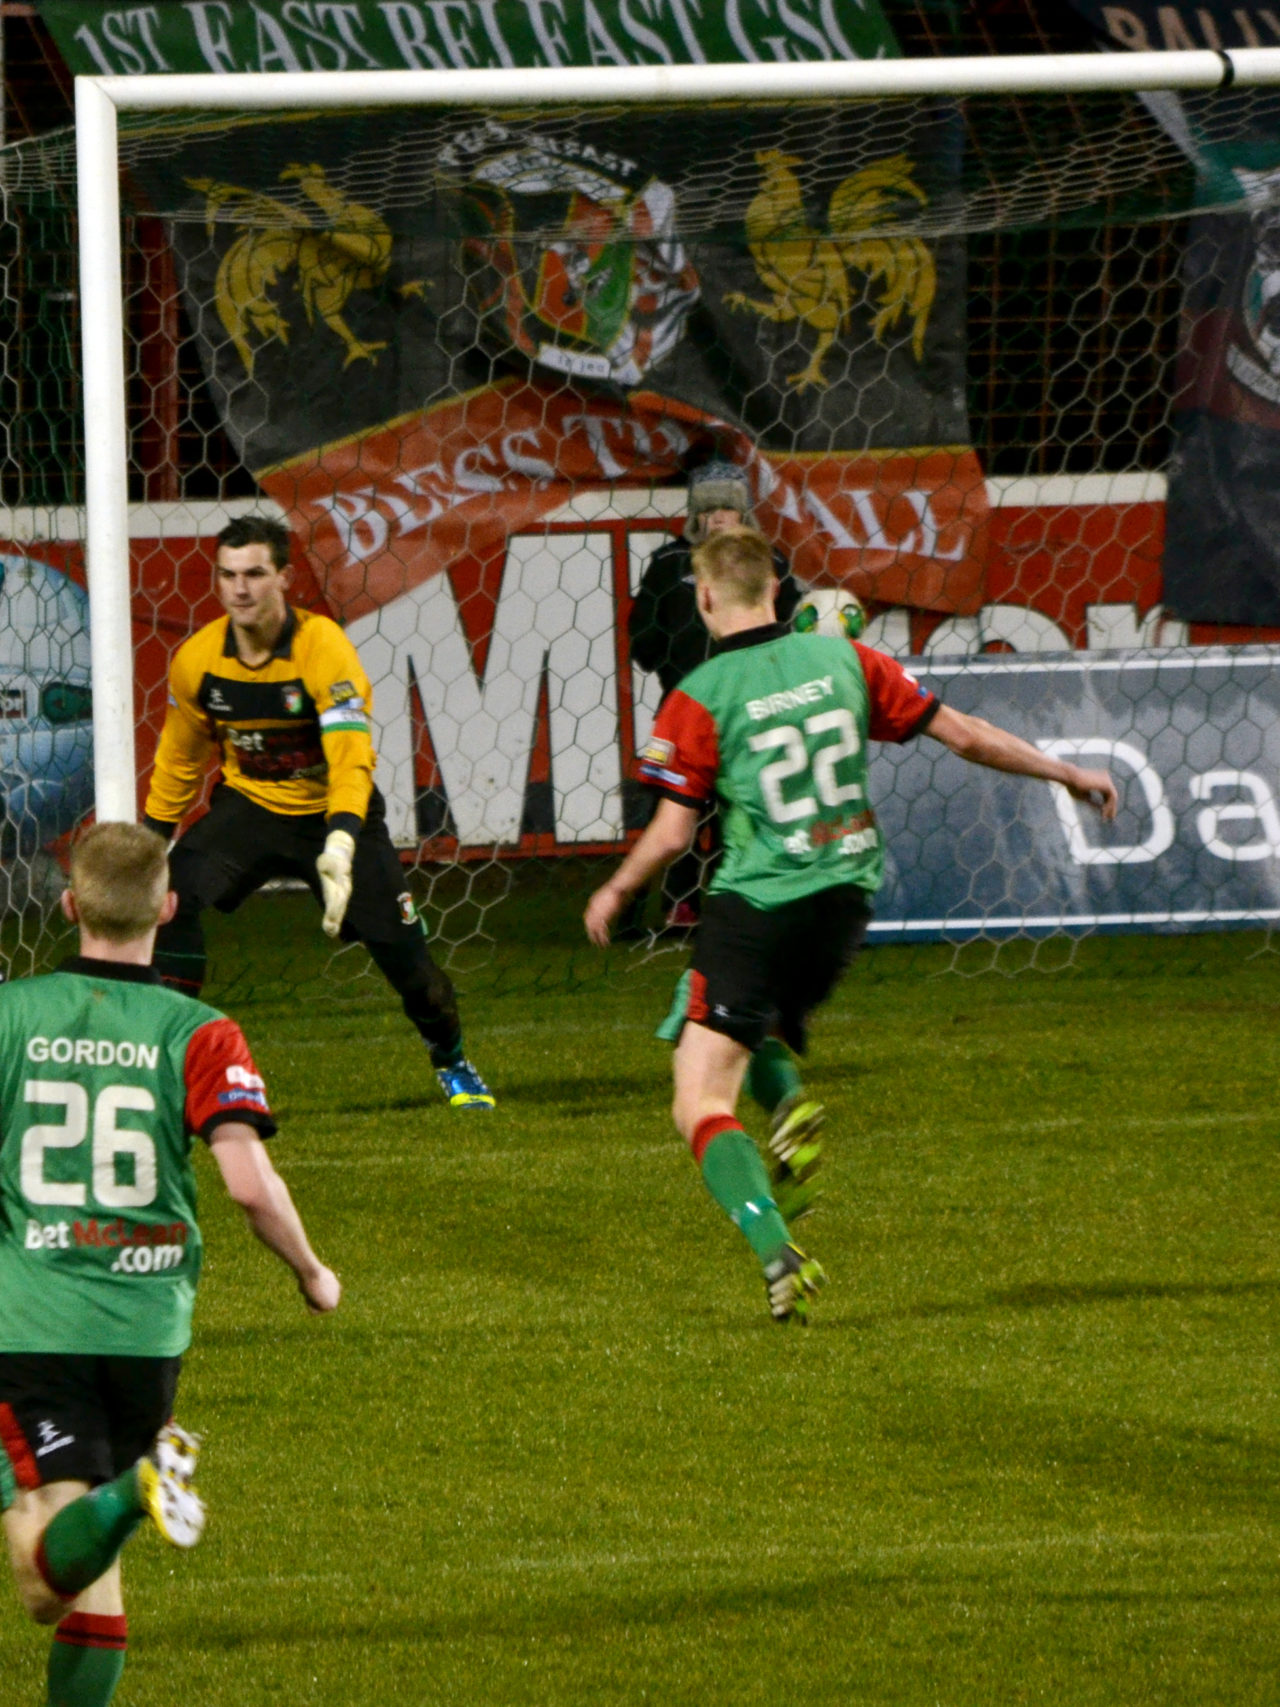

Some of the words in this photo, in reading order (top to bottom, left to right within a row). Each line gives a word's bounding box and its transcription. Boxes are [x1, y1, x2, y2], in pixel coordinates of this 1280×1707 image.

[74, 8, 173, 75] 1ST
[183, 0, 382, 74] EAST
[745, 675, 835, 721] BIRNEY
[747, 708, 864, 825] 22
[27, 1036, 160, 1070] GORDON
[21, 1079, 157, 1208] 26
[110, 1243, 185, 1273] .com
